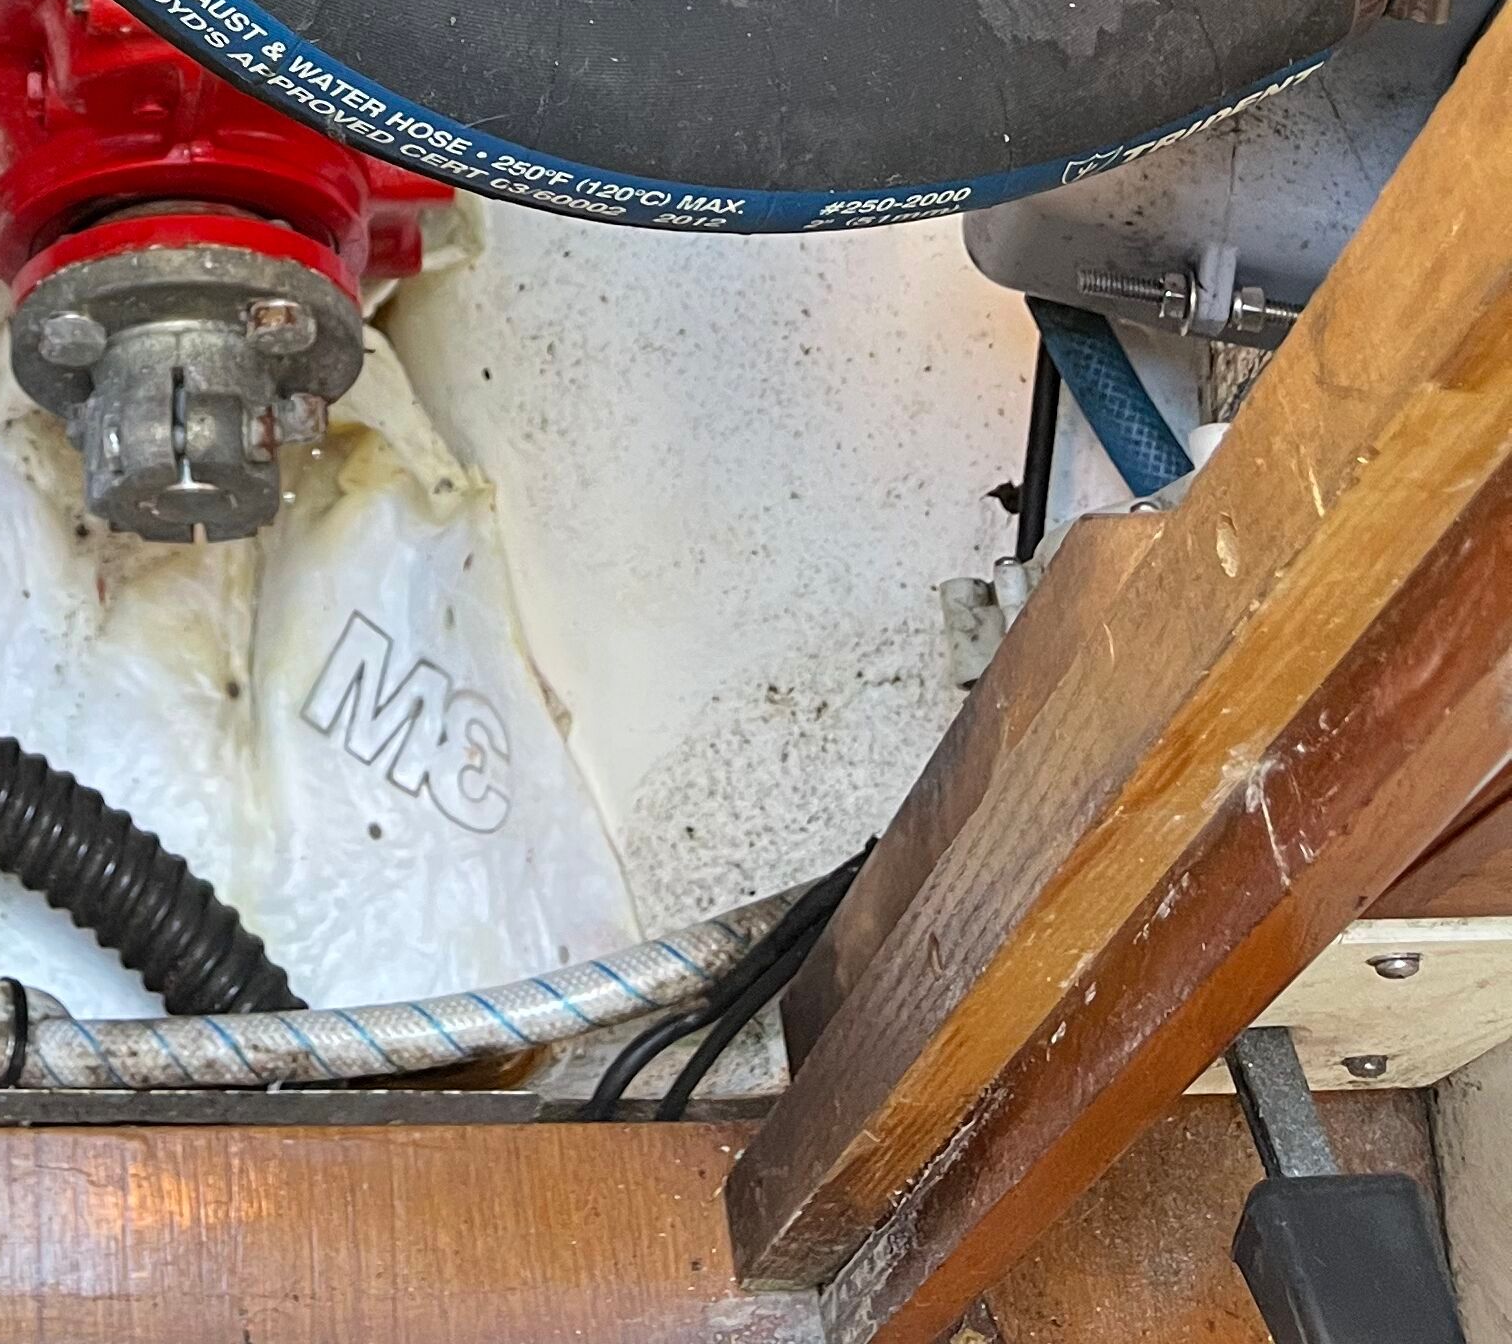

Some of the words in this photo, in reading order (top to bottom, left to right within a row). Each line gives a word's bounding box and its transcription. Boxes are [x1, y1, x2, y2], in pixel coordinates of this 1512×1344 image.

[227, 51, 396, 145] APPROVED
[399, 143, 490, 179] CERT
[652, 213, 727, 228] 2012
[261, 41, 286, 62] &
[288, 55, 387, 118] WATER
[392, 111, 473, 156] HOSE
[676, 194, 747, 215] MAX.
[1122, 60, 1326, 164] TRIDENT
[819, 187, 972, 216] #250-2000
